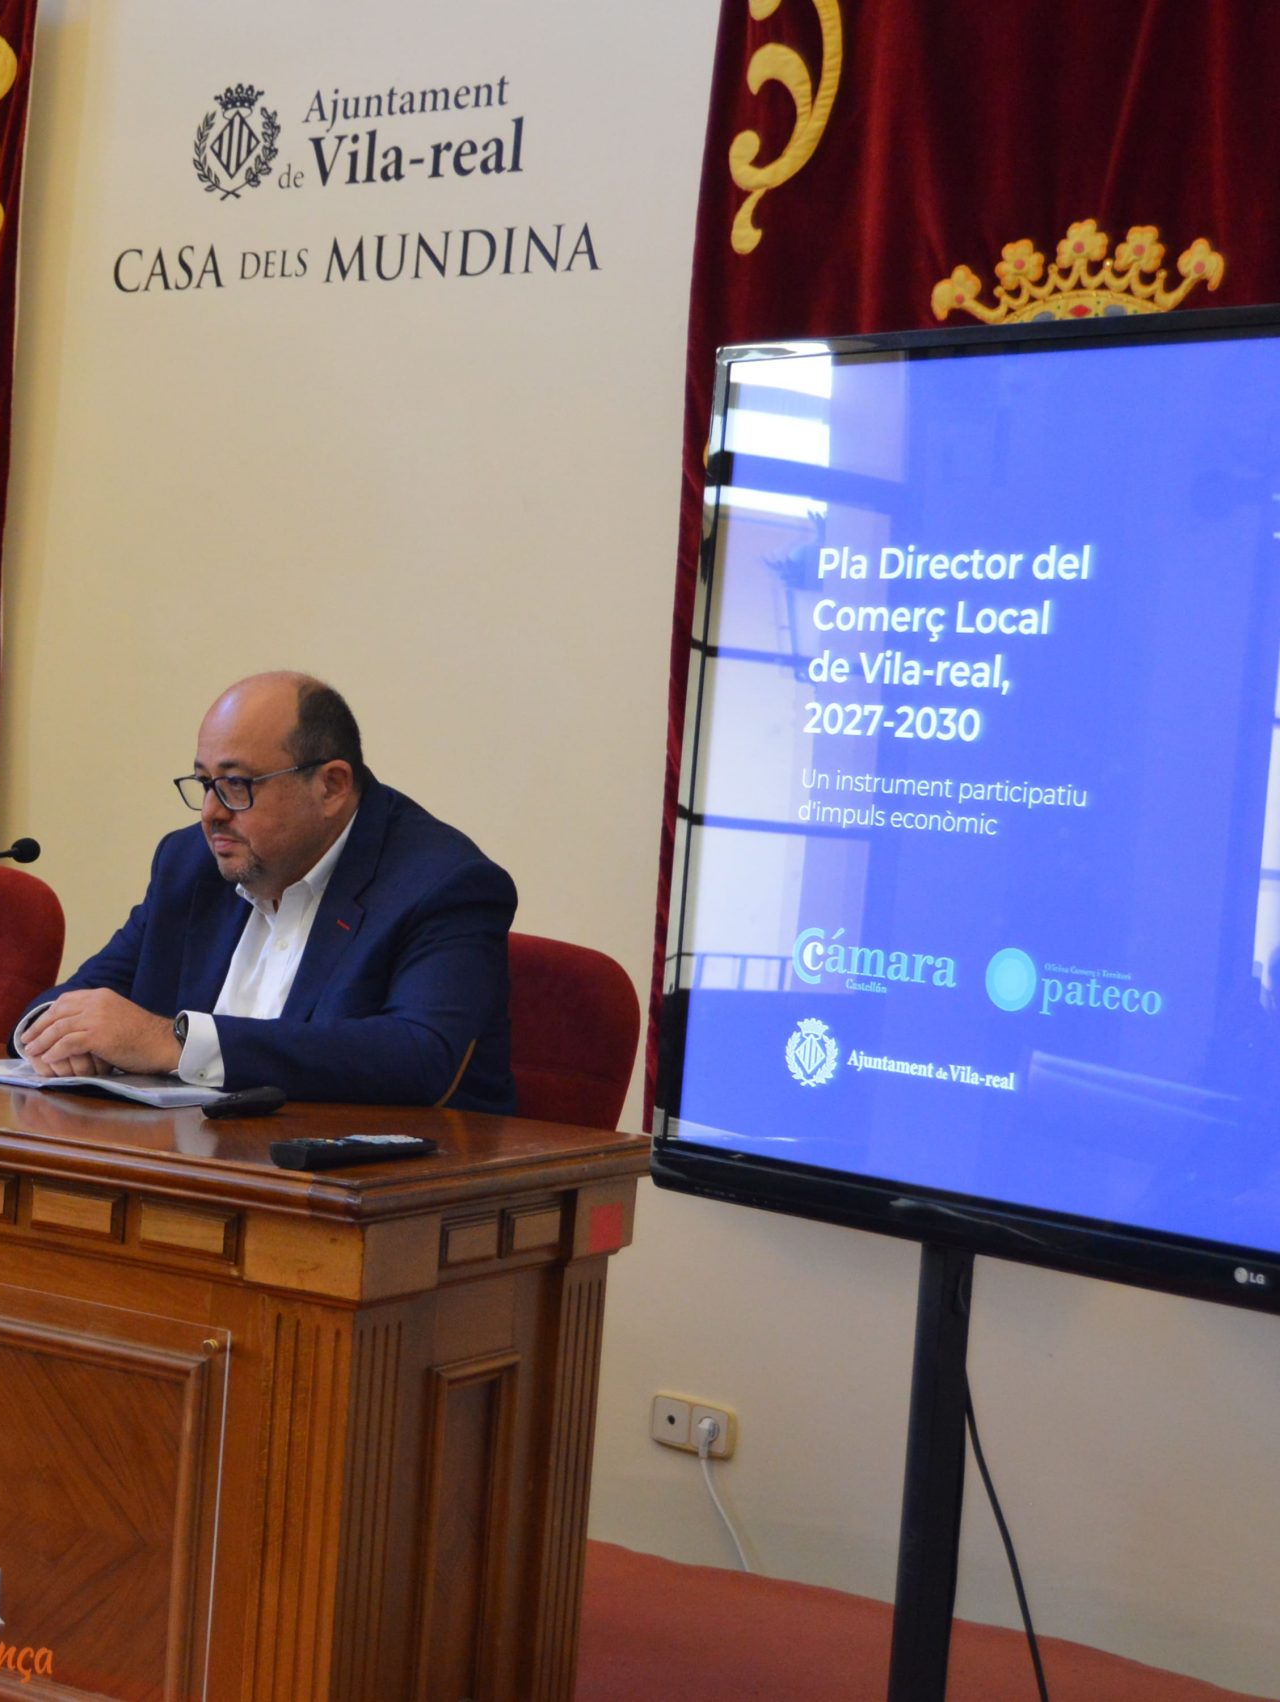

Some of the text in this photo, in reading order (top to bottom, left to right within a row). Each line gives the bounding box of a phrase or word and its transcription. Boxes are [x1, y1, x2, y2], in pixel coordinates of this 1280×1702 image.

[302, 75, 510, 131] Ajuntament
[278, 116, 525, 190] de Vila-real
[113, 222, 602, 293] CASA DELS MUNDINA
[817, 544, 1091, 580] Pla Director del
[812, 598, 1051, 642] Comerç Local
[808, 650, 1010, 696] de Vila-real,
[802, 701, 981, 743] 2027-2030
[801, 768, 1088, 808] Un instrument participatiu
[798, 800, 998, 835] d'impuls econòmic
[792, 927, 957, 988] Cámara
[1039, 977, 1162, 1016] pateco
[847, 1049, 1016, 1091] Ajuntament de Vila-real
[1249, 1271, 1266, 1285] LG
